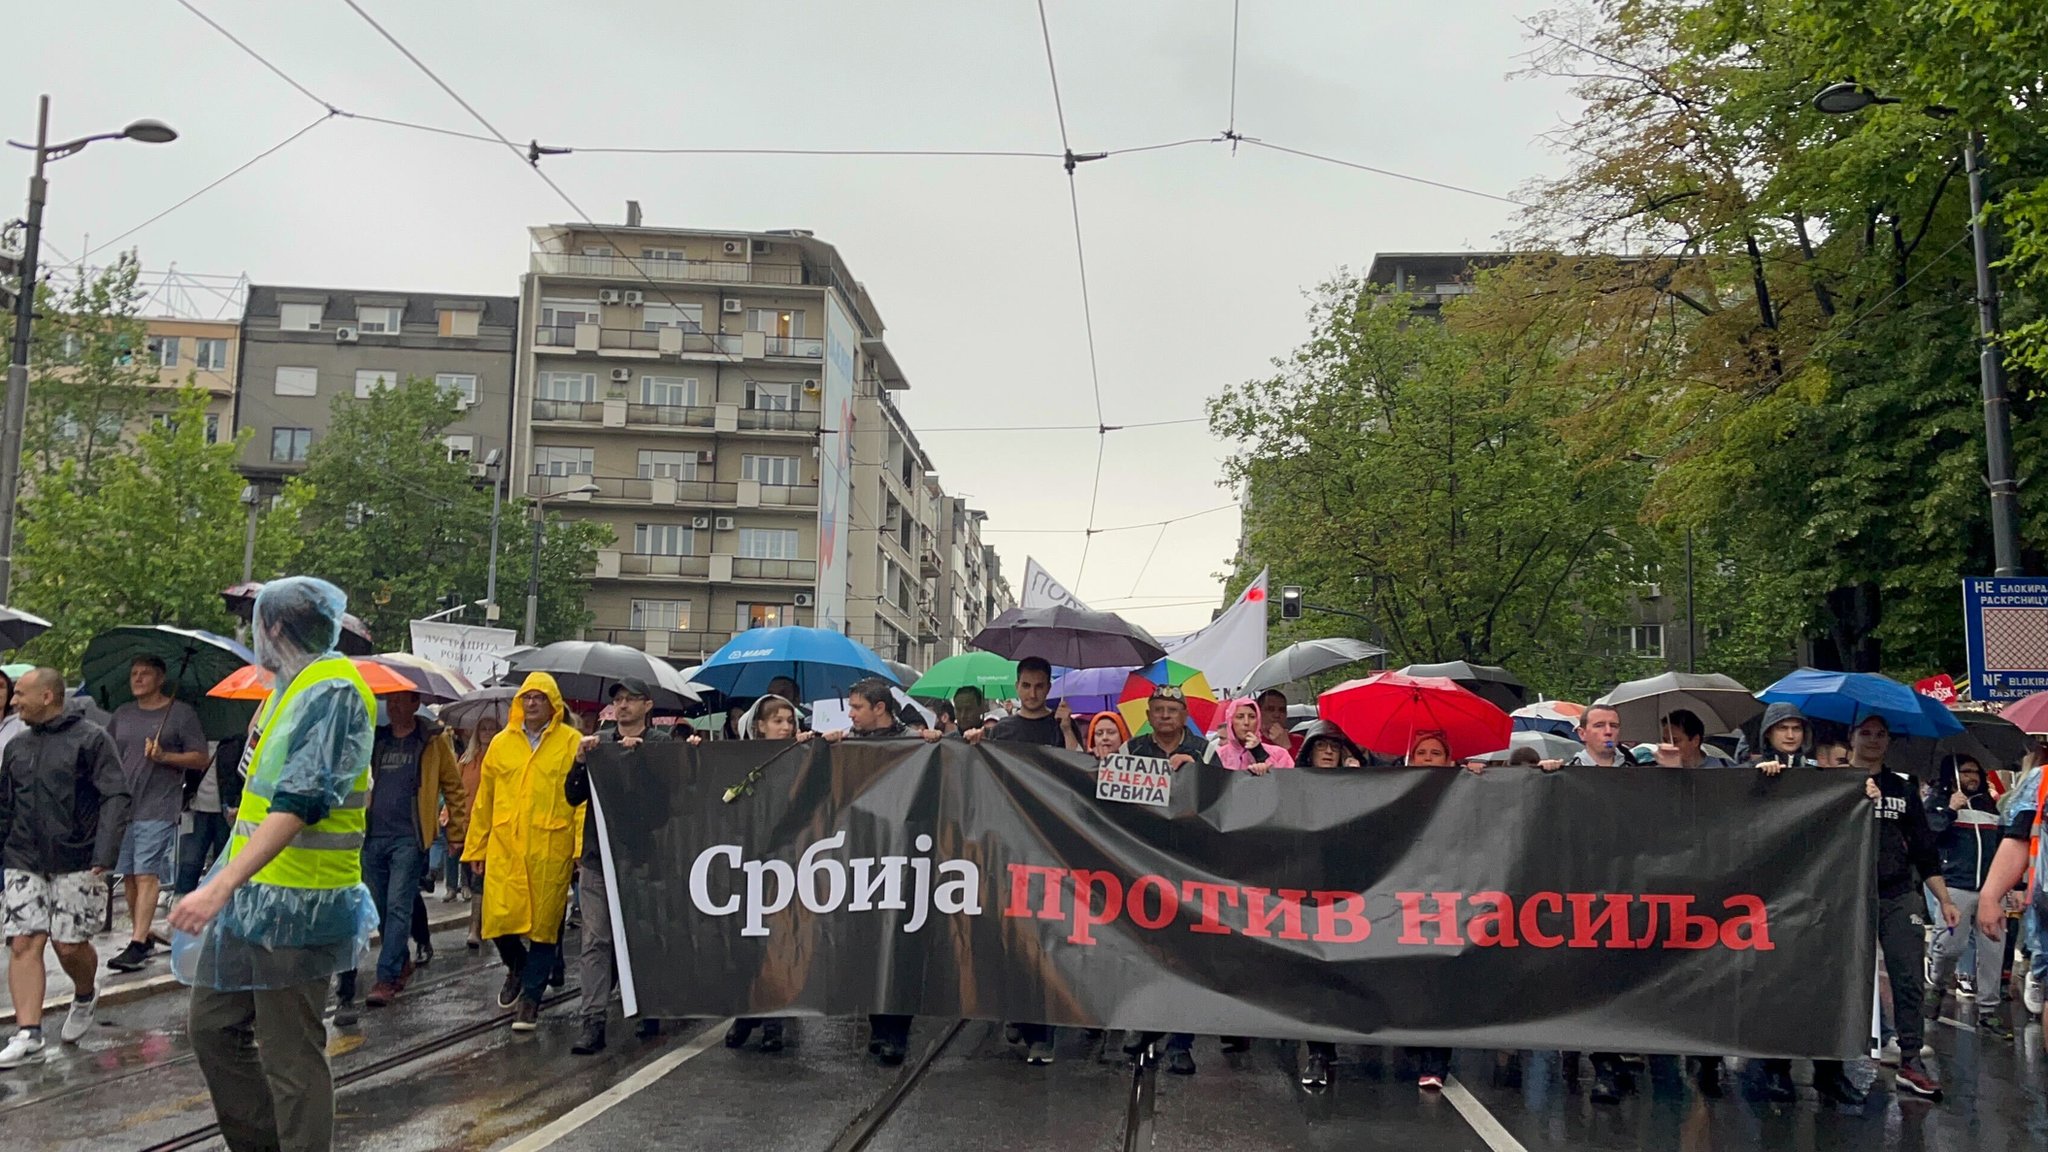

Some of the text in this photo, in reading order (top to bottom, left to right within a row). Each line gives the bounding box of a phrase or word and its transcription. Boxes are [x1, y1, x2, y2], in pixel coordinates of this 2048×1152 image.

[1974, 581, 2048, 593] НЕ БЛОКИРА
[424, 634, 498, 652] ЛУСТРАЦИЈА
[440, 650, 482, 662] РОБИЈА
[1101, 755, 1171, 776] УСТАЛА
[1119, 772, 1168, 788] ЦЕЛА
[1099, 782, 1165, 803] СРБИЈА
[690, 831, 1775, 951] Србија против насиља
